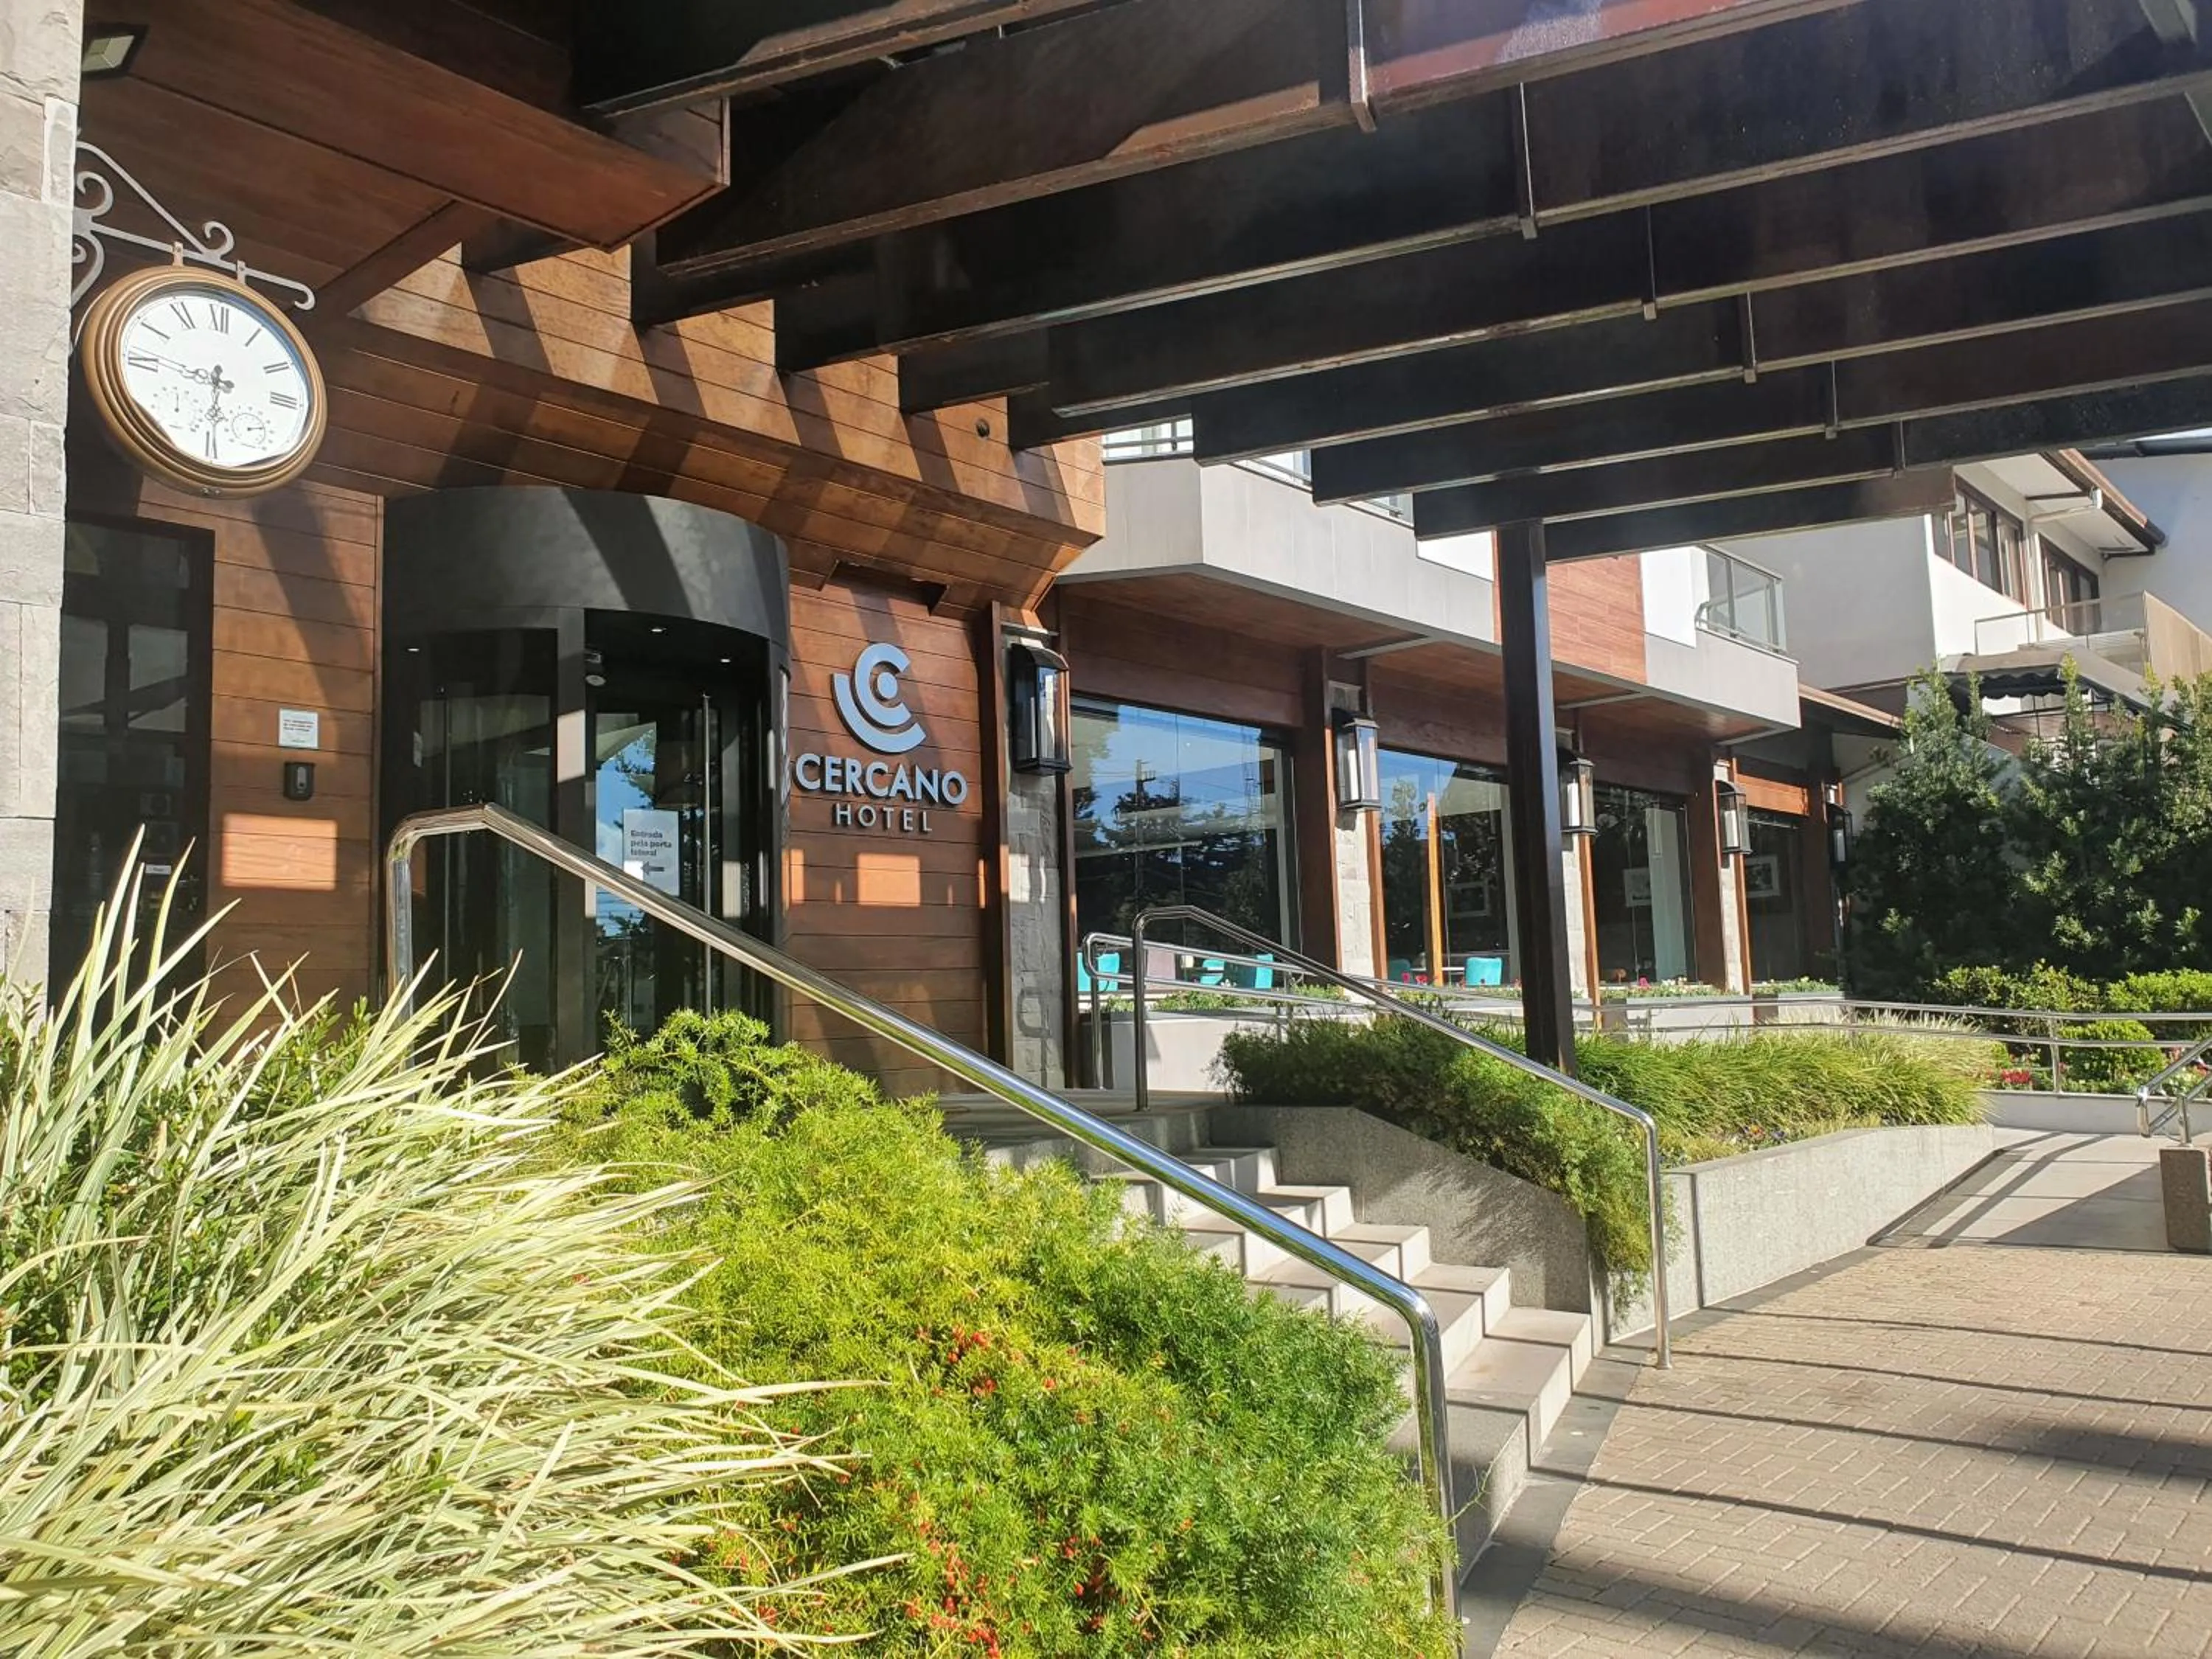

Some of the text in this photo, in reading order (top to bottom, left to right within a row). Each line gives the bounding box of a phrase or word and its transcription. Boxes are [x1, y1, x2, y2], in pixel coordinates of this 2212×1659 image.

[796, 754, 967, 804] CERCANO
[836, 803, 933, 831] HOTEL
[650, 841, 672, 849] porta
